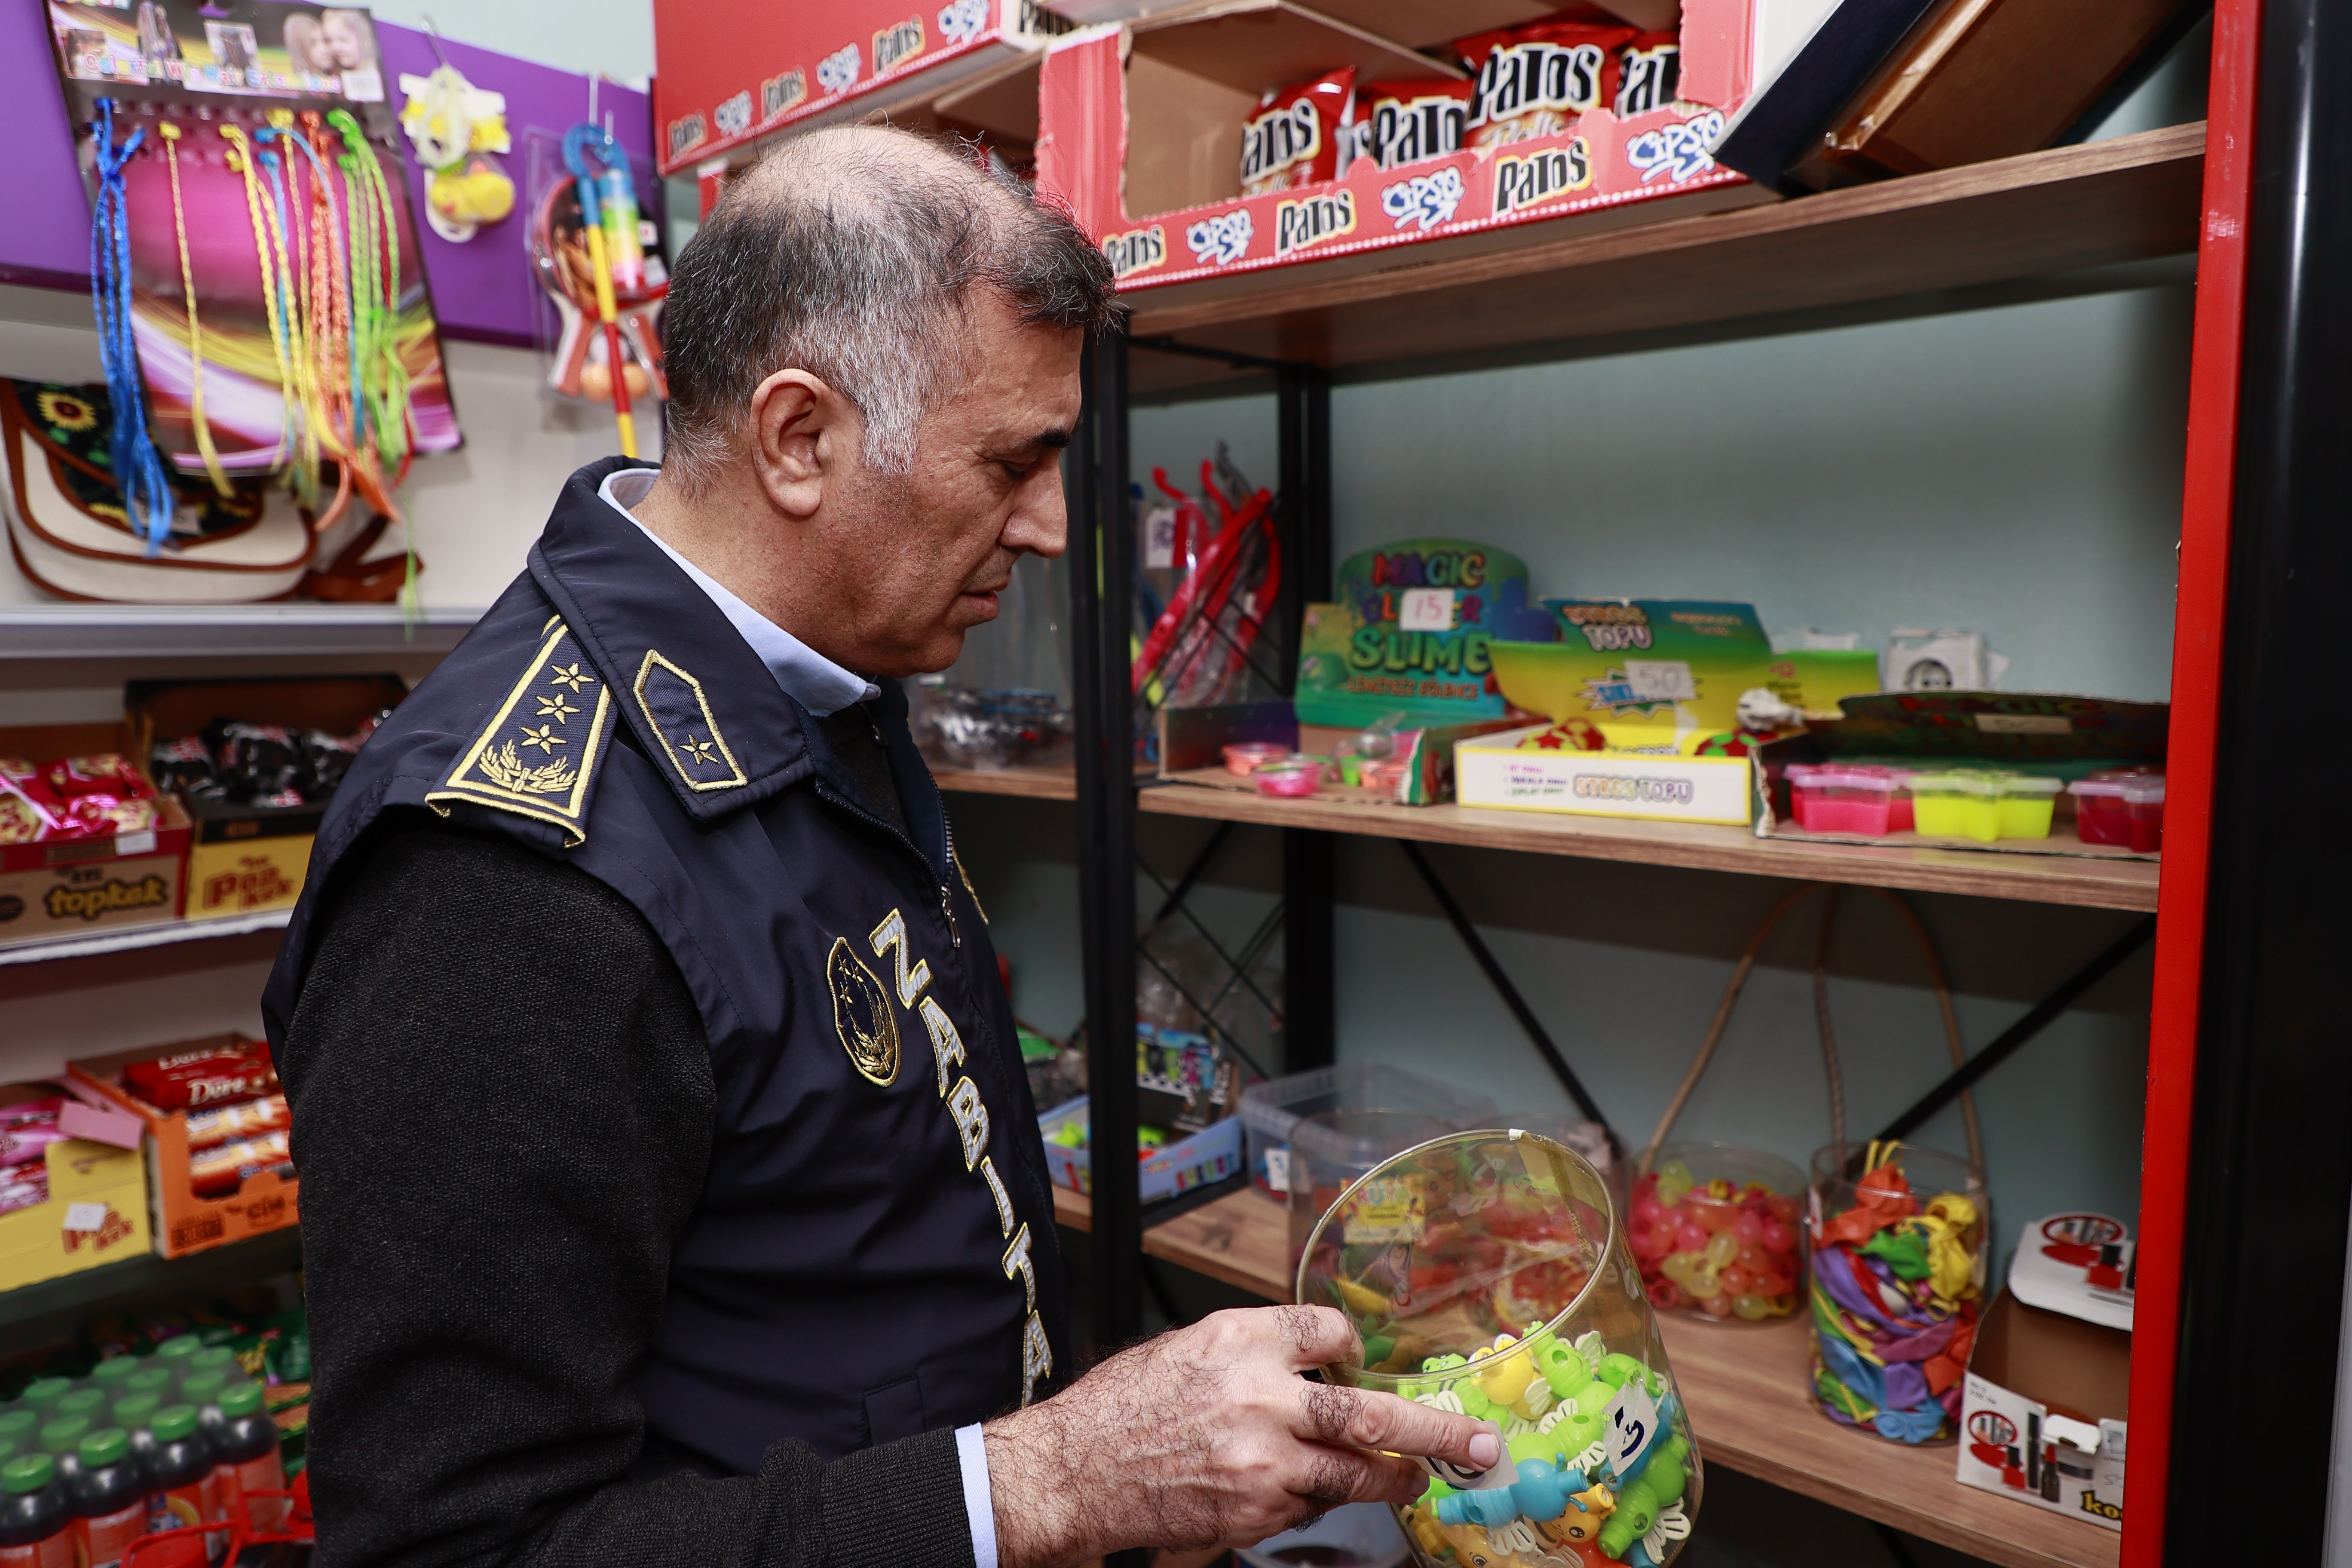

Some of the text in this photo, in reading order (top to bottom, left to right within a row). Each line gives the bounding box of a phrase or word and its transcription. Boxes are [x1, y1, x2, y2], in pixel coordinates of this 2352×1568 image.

[1372, 552, 1485, 587] MAGIC
[1414, 594, 1443, 621] 15
[1352, 626, 1492, 675] SLIME
[1582, 623, 1653, 652] TOPU
[1639, 665, 1681, 690] 50
[1638, 777, 1694, 805] TOPU
[46, 874, 167, 920] topkek
[869, 907, 1053, 1409] ZABITA
